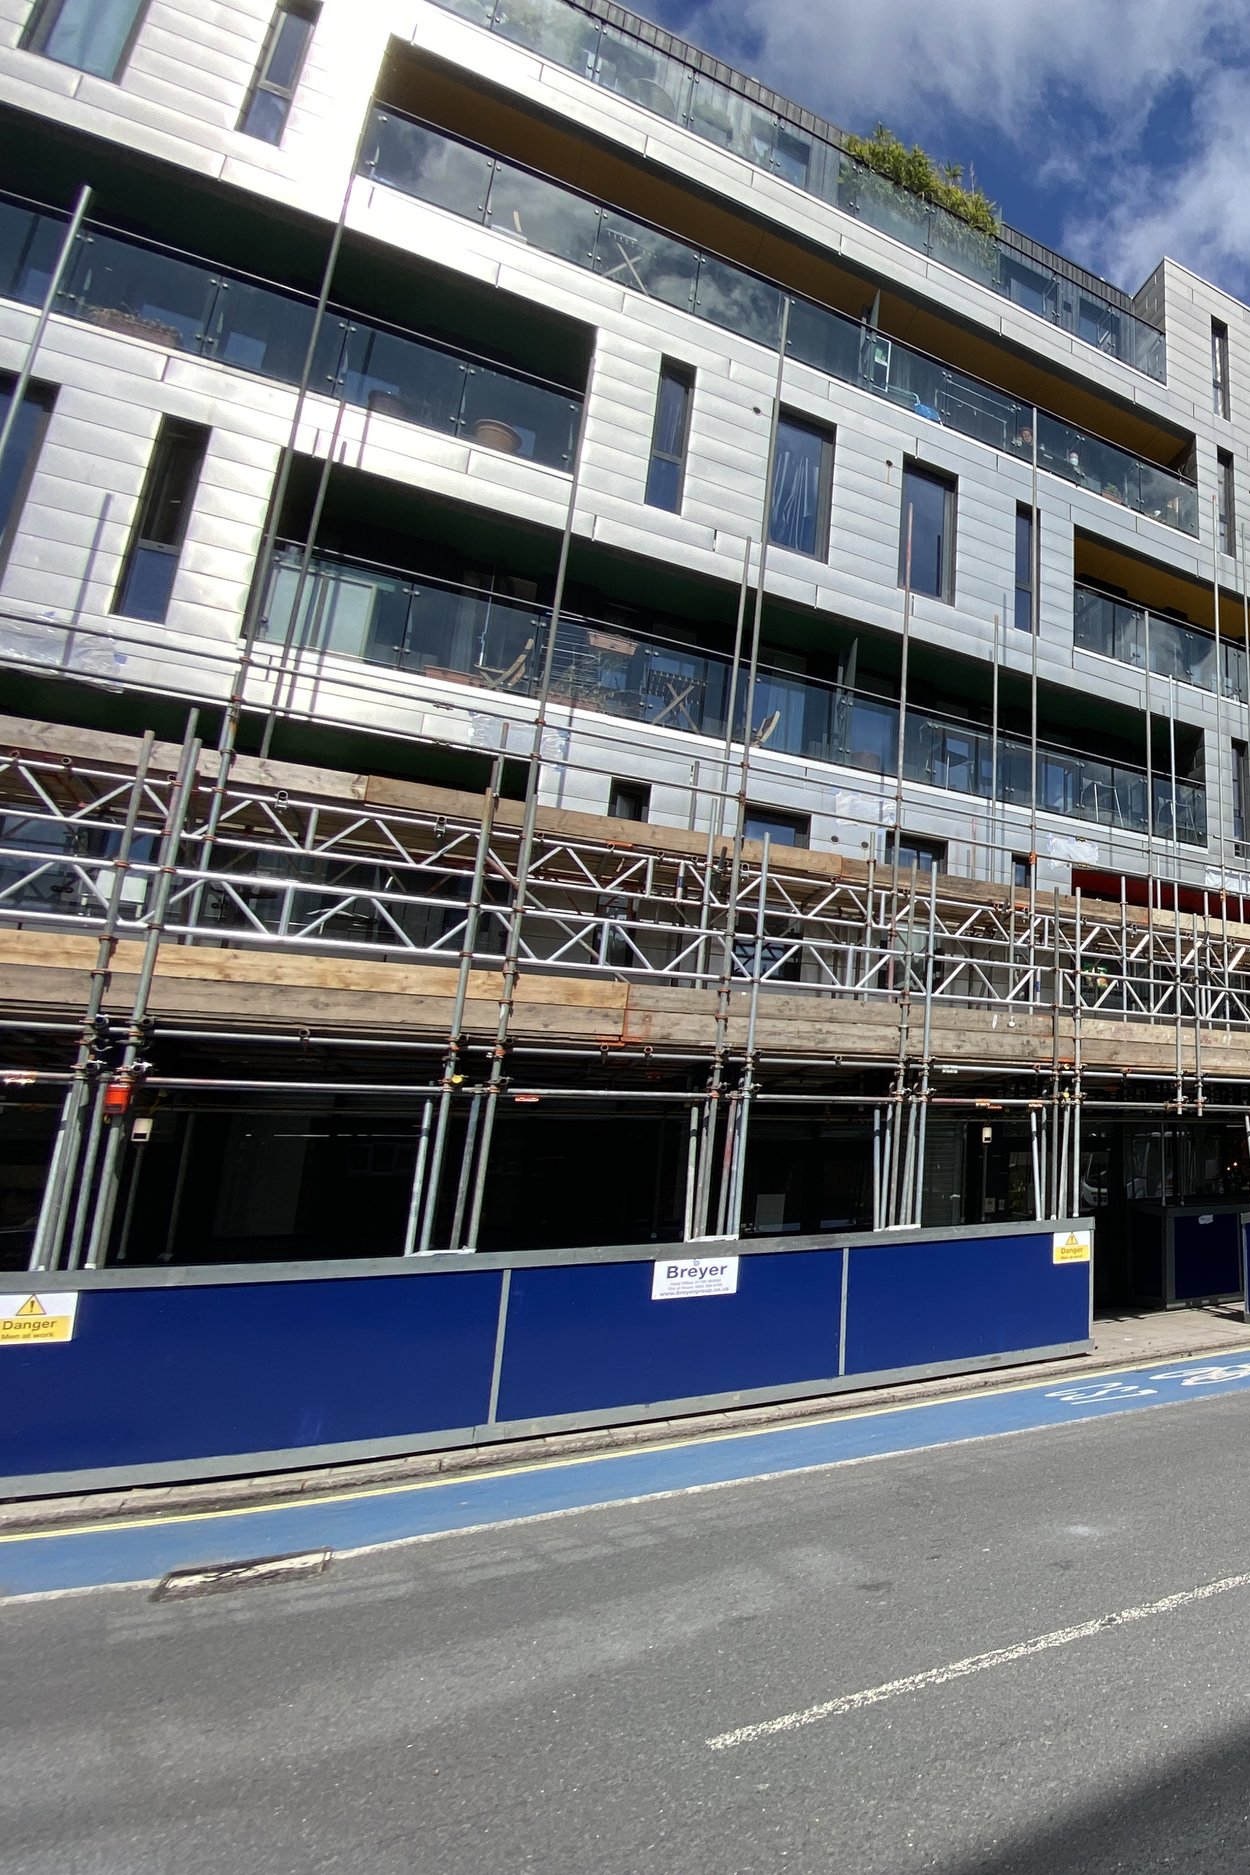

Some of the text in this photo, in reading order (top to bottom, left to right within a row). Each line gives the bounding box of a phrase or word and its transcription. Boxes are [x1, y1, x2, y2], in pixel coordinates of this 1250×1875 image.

[1060, 1247, 1083, 1255] Danger
[666, 1264, 728, 1280] Breyer
[2, 1320, 58, 1332] Danger
